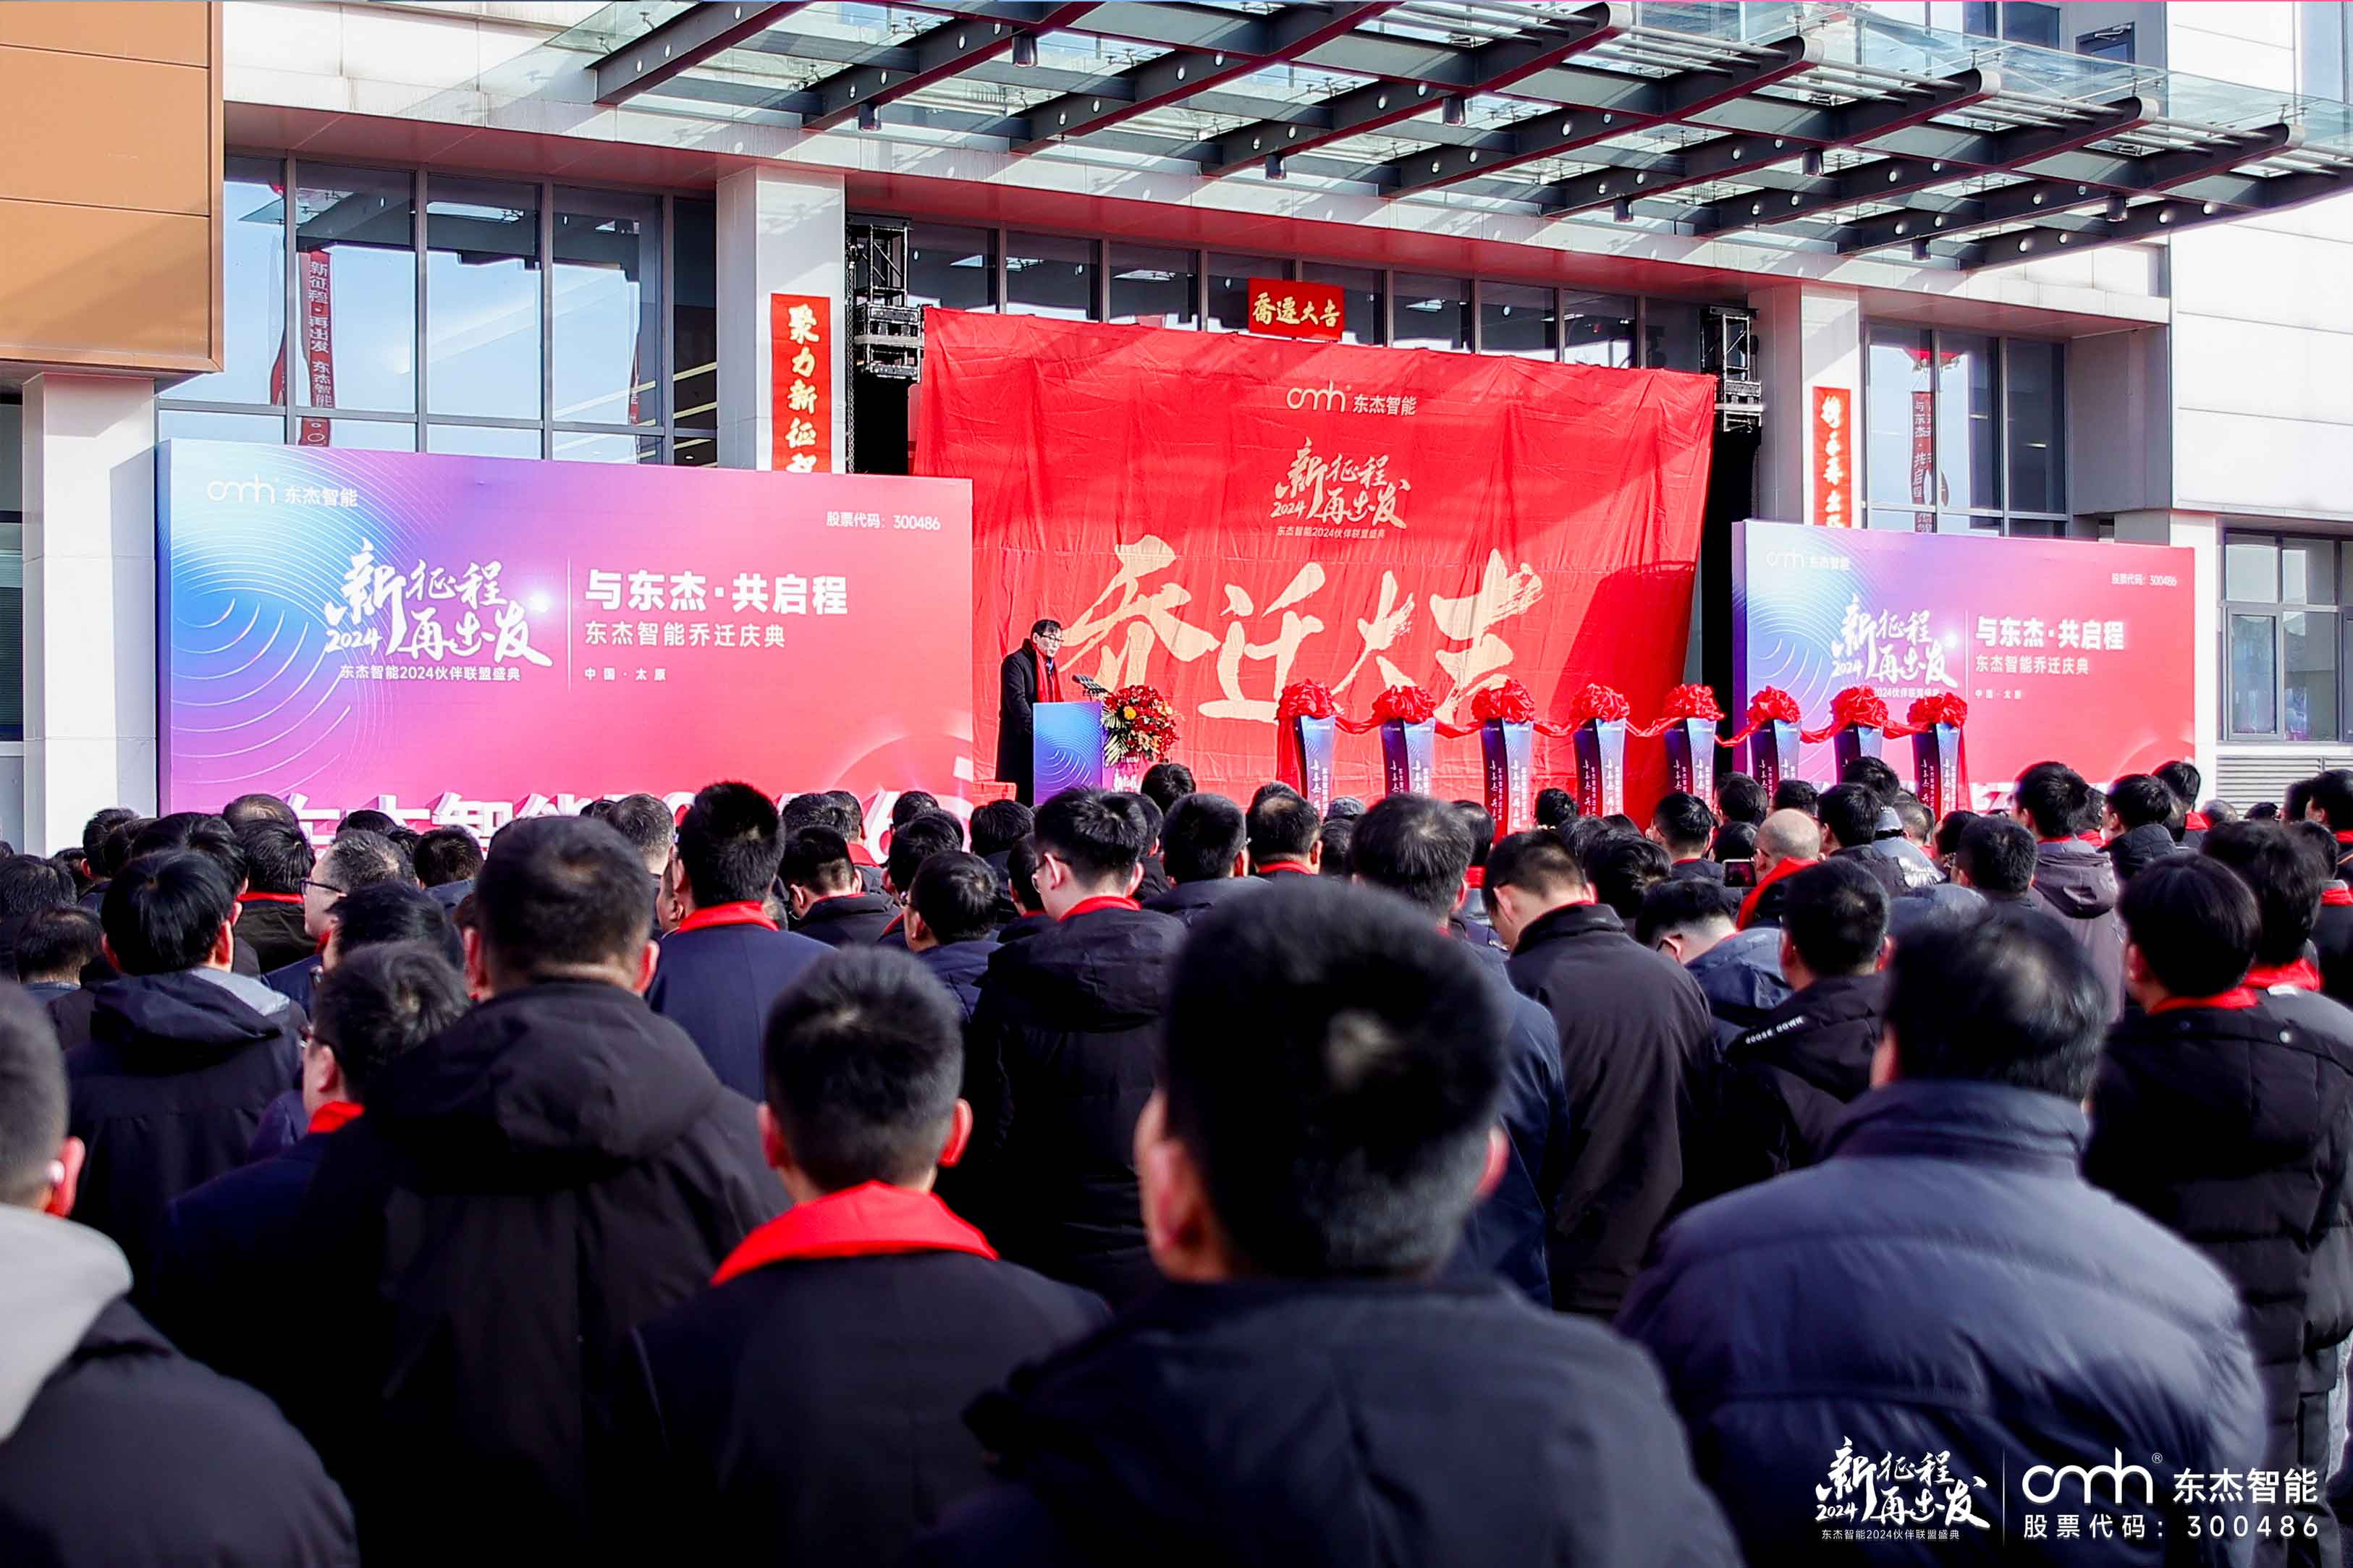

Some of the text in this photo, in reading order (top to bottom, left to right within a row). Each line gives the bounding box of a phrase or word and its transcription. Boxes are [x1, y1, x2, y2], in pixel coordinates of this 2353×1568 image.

[1353, 394, 1417, 416] 东杰智能
[284, 487, 358, 507] 东杰智能
[1270, 501, 1306, 520] 2024
[892, 514, 941, 531] 300486
[585, 567, 849, 616] 与东杰·共启程
[2149, 575, 2177, 587] 300486
[585, 619, 785, 649] 东杰智能乔迁庆典
[1058, 534, 1544, 724] 乔迁大吉
[1975, 616, 2126, 650] 与东杰·共启程
[323, 627, 381, 656] 2024
[340, 664, 521, 682] 东杰智能2024伙伴联盟盛典
[1830, 660, 1864, 678] 2024
[1975, 653, 2090, 675] 东杰智能乔迁庆典
